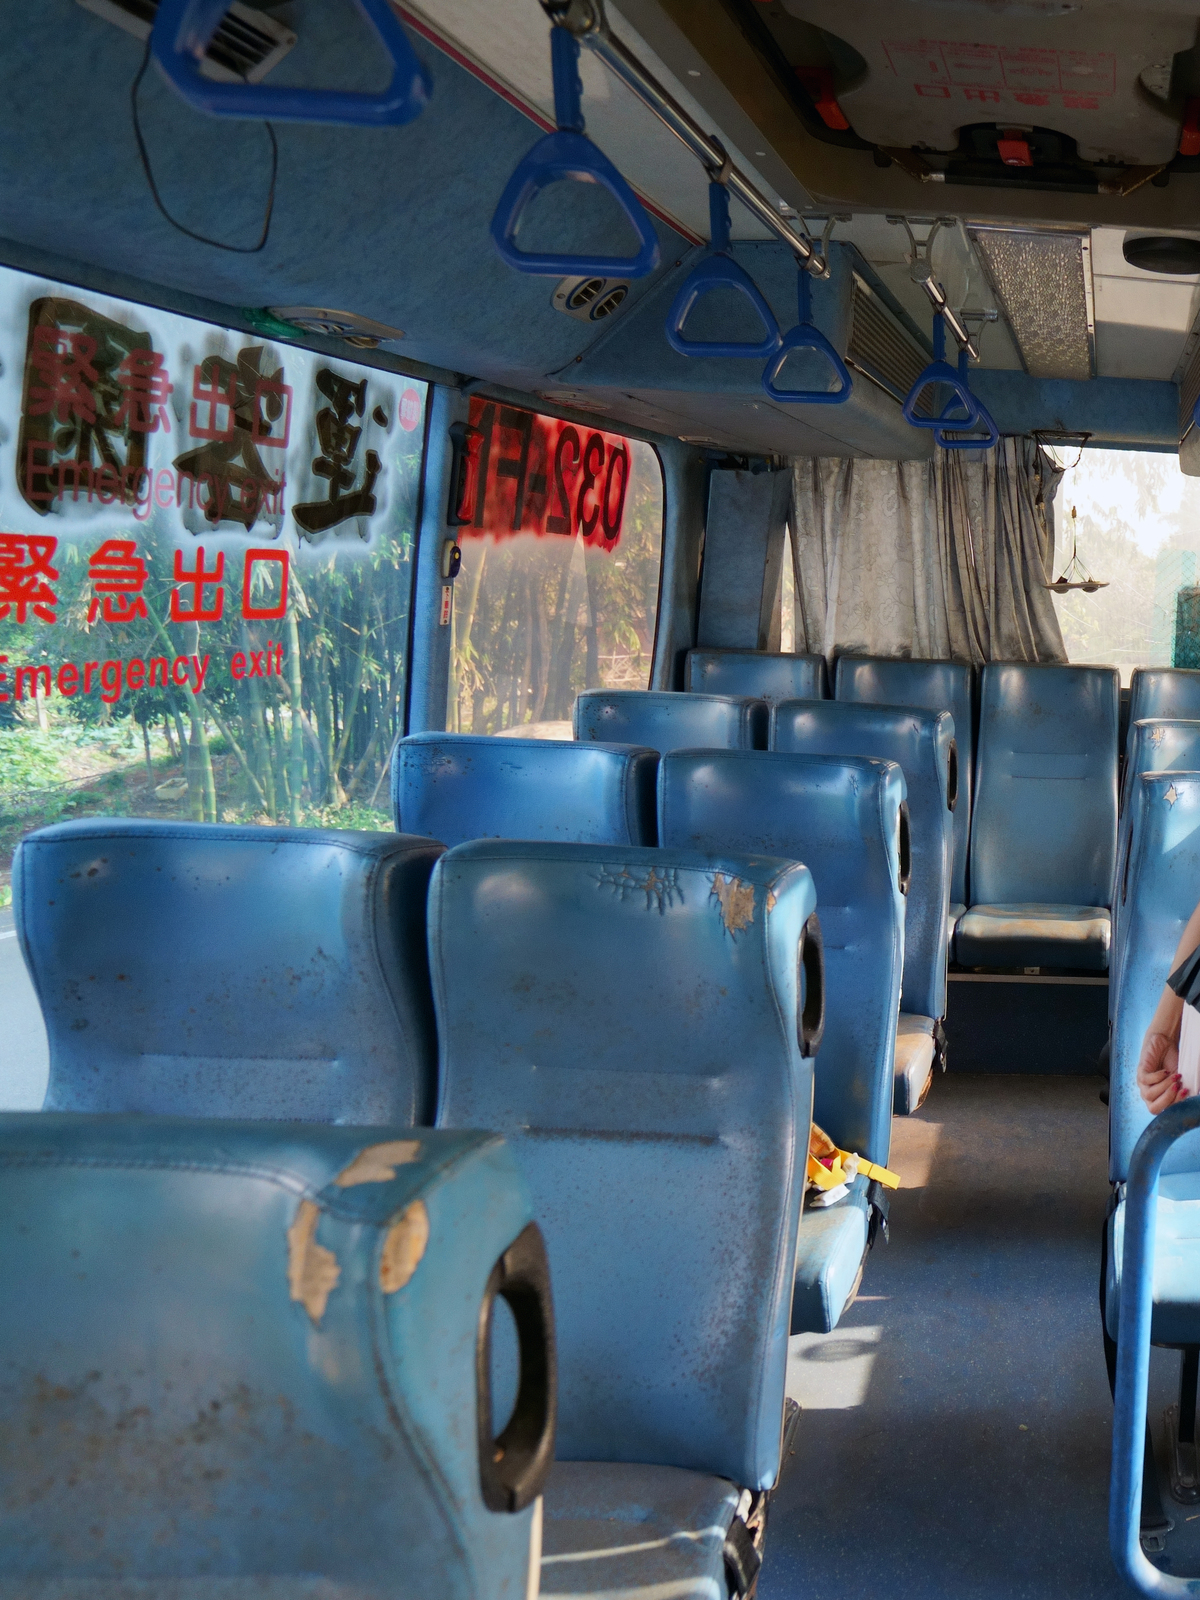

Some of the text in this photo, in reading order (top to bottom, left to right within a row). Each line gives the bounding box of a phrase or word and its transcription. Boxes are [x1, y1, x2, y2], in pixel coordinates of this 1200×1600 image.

[28, 325, 294, 449] 緊急出口
[26, 439, 288, 525] Emergency exit
[0, 532, 290, 624] 緊急出口
[230, 640, 284, 680] exit
